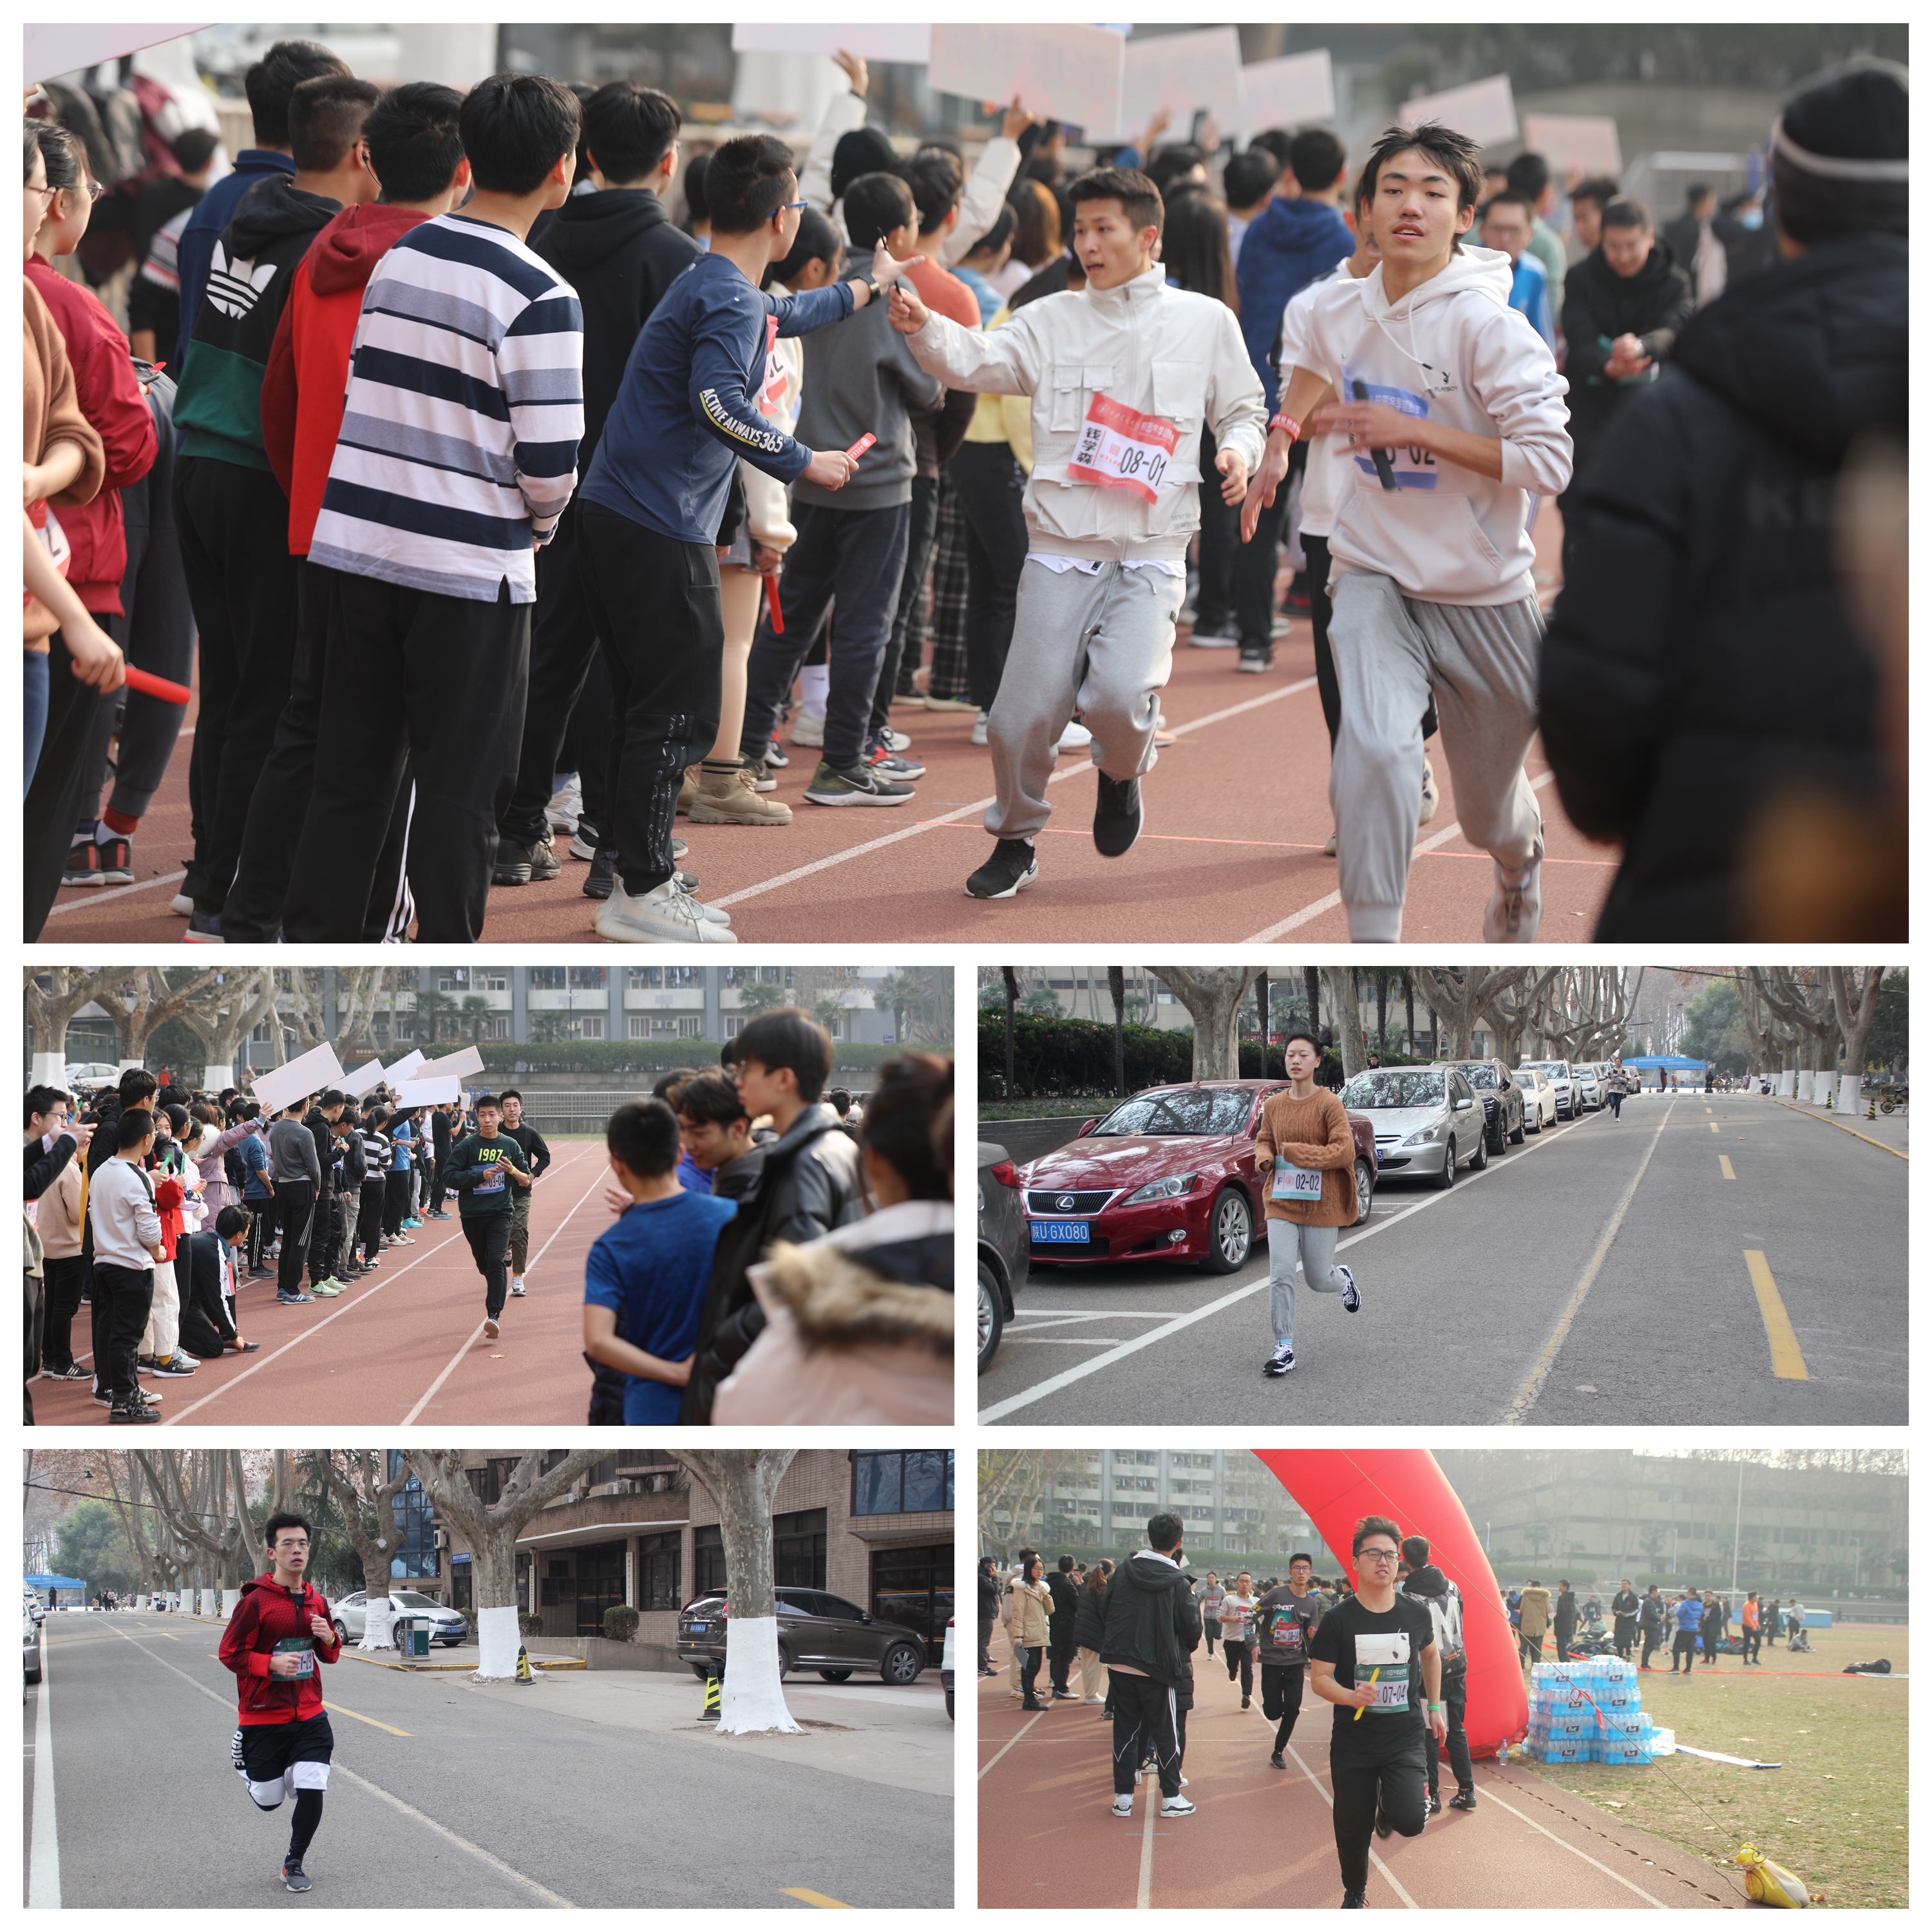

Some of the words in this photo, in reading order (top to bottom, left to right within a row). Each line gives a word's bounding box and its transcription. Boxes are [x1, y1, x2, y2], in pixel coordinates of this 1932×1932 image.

[702, 388, 728, 423] ACTIVE
[723, 416, 762, 443] ALWAYS
[758, 432, 784, 453] 365
[1076, 426, 1102, 465] 钱学森
[1120, 446, 1167, 486] 08-01
[478, 1148, 504, 1162] 1987
[489, 1175, 504, 1188] 03-04
[1296, 1174, 1320, 1191] 02-02
[1032, 1225, 1088, 1240] 陕U·GX080
[1383, 1685, 1406, 1703] 07-04
